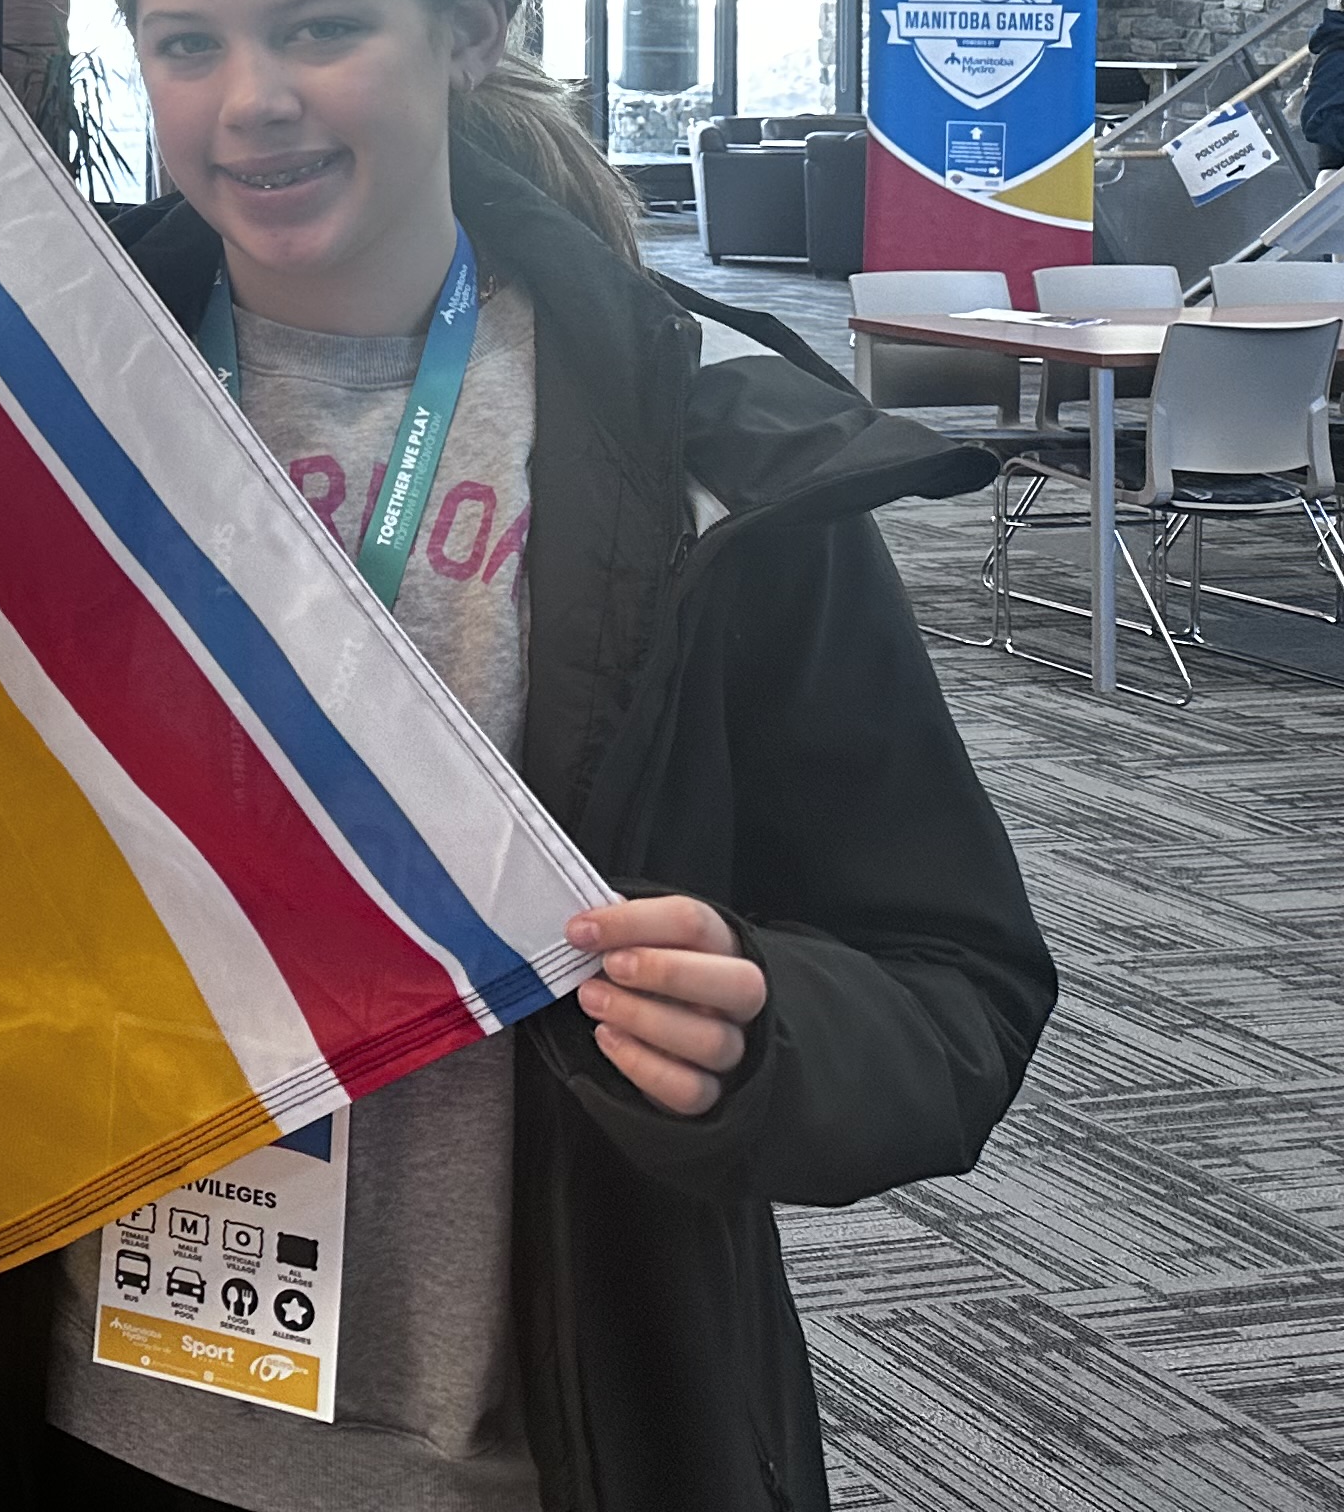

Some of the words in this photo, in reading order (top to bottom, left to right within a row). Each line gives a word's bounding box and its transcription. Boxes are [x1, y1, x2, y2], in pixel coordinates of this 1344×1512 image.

[905, 11, 991, 31] MANITOBA
[996, 12, 1055, 32] GAMES
[962, 56, 1014, 67] Manitoba
[962, 65, 996, 76] Hydro
[1195, 130, 1240, 162] POLYCLINIC
[1200, 143, 1256, 181] POLYCLINIQUE
[408, 405, 431, 447] PLAY
[400, 444, 420, 471] WE
[376, 471, 413, 546] TOGETHER
[181, 1177, 278, 1210] IVILEGES
[180, 1217, 198, 1236] M
[120, 1238, 150, 1251] VILLAGE
[235, 1230, 251, 1247] O
[173, 1249, 202, 1263] VILLAGE
[177, 1243, 198, 1253] MALE
[226, 1261, 256, 1276] VILLAGE
[123, 1293, 140, 1304] BUS
[170, 1300, 200, 1314] MOTOR
[174, 1309, 195, 1322] POOL
[180, 1334, 235, 1364] Sport
